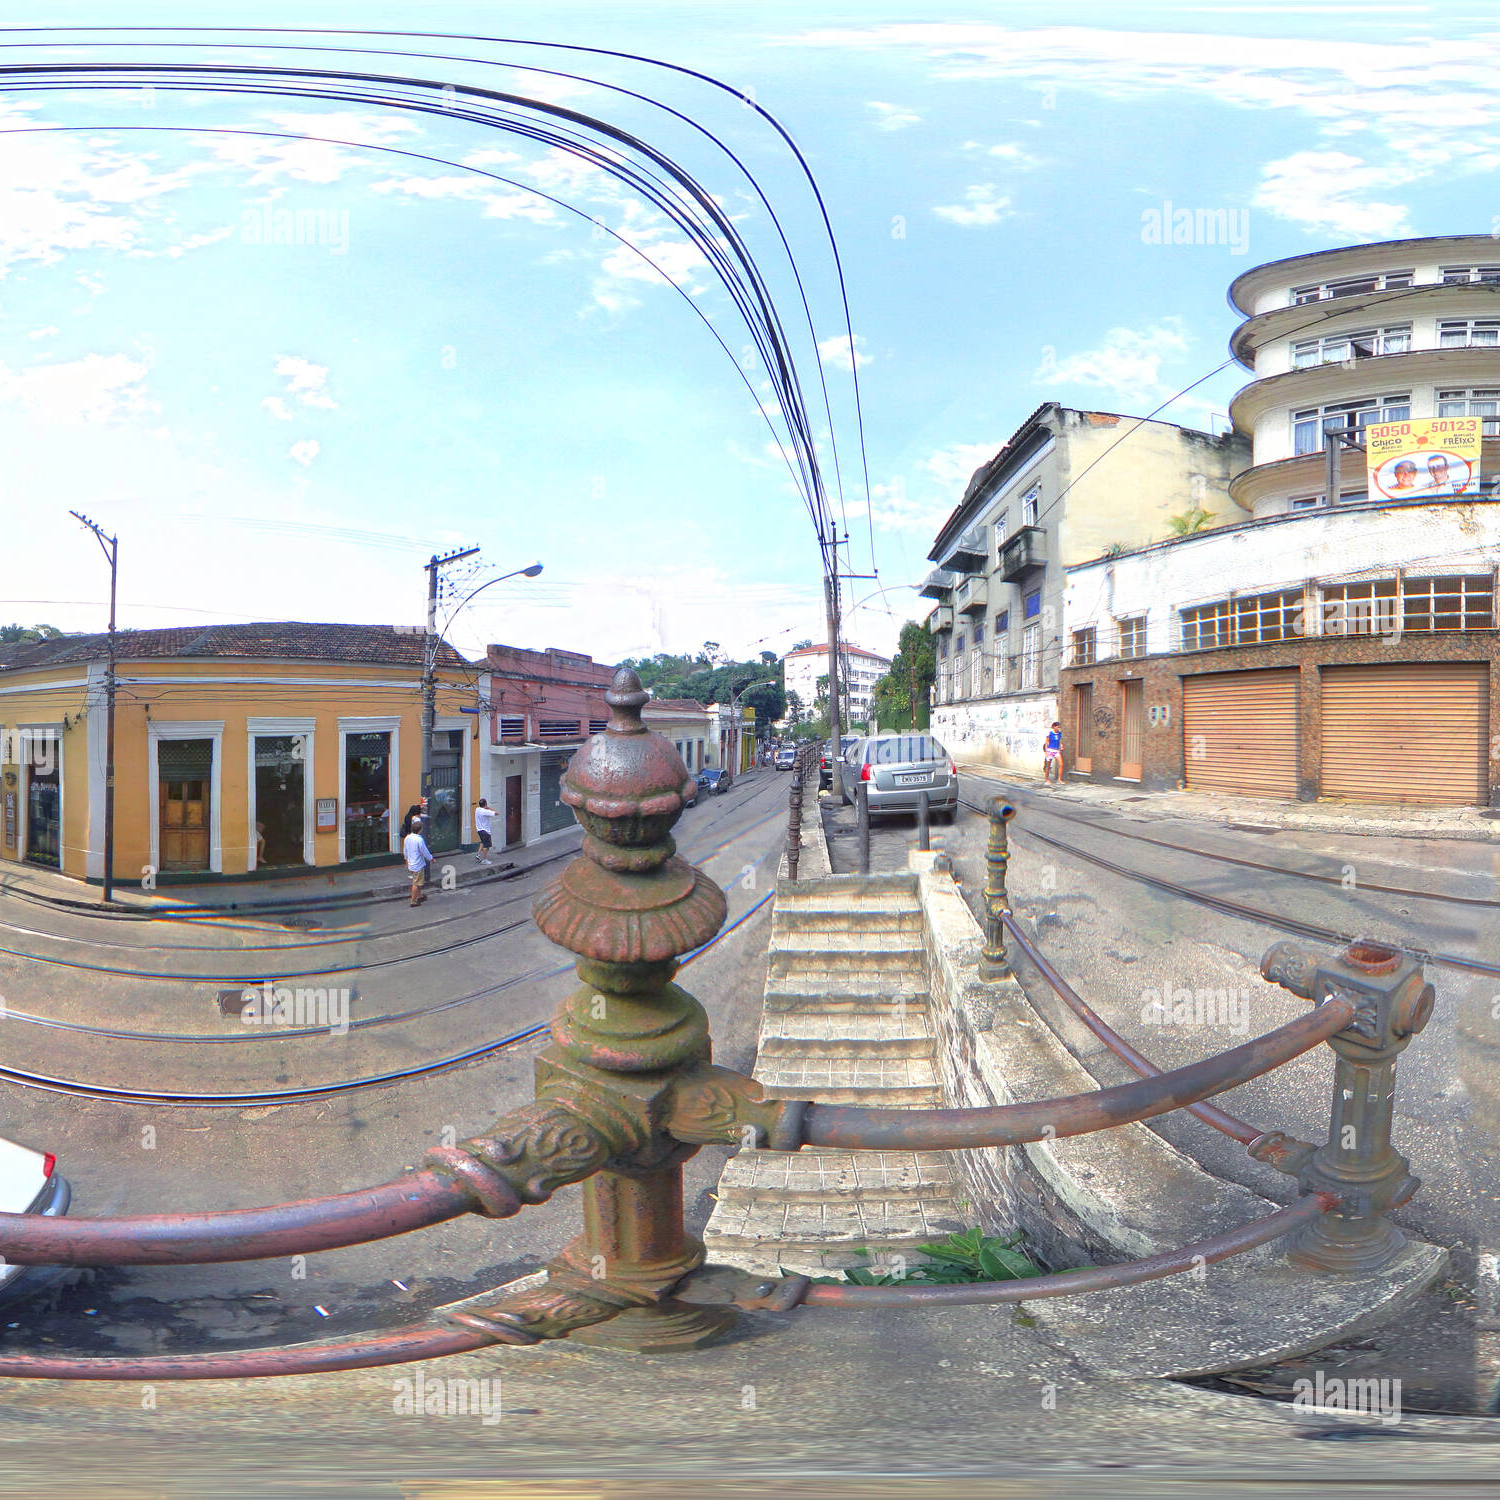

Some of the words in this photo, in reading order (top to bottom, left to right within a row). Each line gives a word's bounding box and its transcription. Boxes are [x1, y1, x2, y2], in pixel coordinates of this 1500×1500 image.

[1371, 423, 1411, 439] 5050
[1431, 420, 1477, 433] 50123
[1443, 437, 1475, 445] FREIXO
